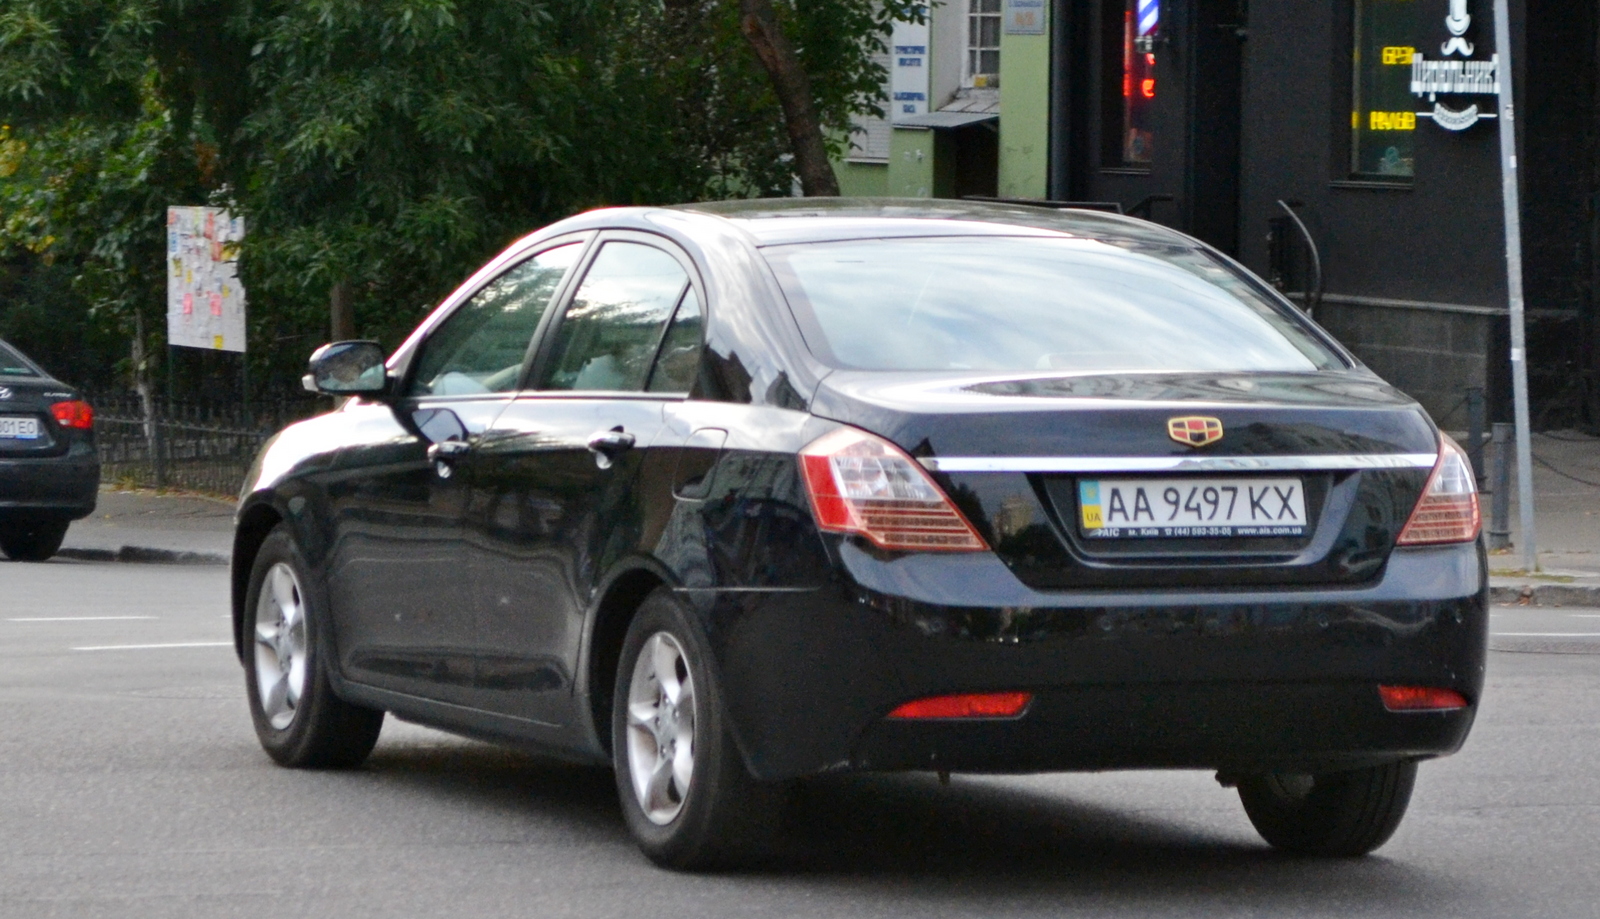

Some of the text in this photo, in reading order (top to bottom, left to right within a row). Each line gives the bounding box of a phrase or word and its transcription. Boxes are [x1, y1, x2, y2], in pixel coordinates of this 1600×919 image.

[0, 421, 15, 434] 01
[1108, 486, 1298, 522] AA 9497 KX
[1086, 513, 1102, 522] UA
